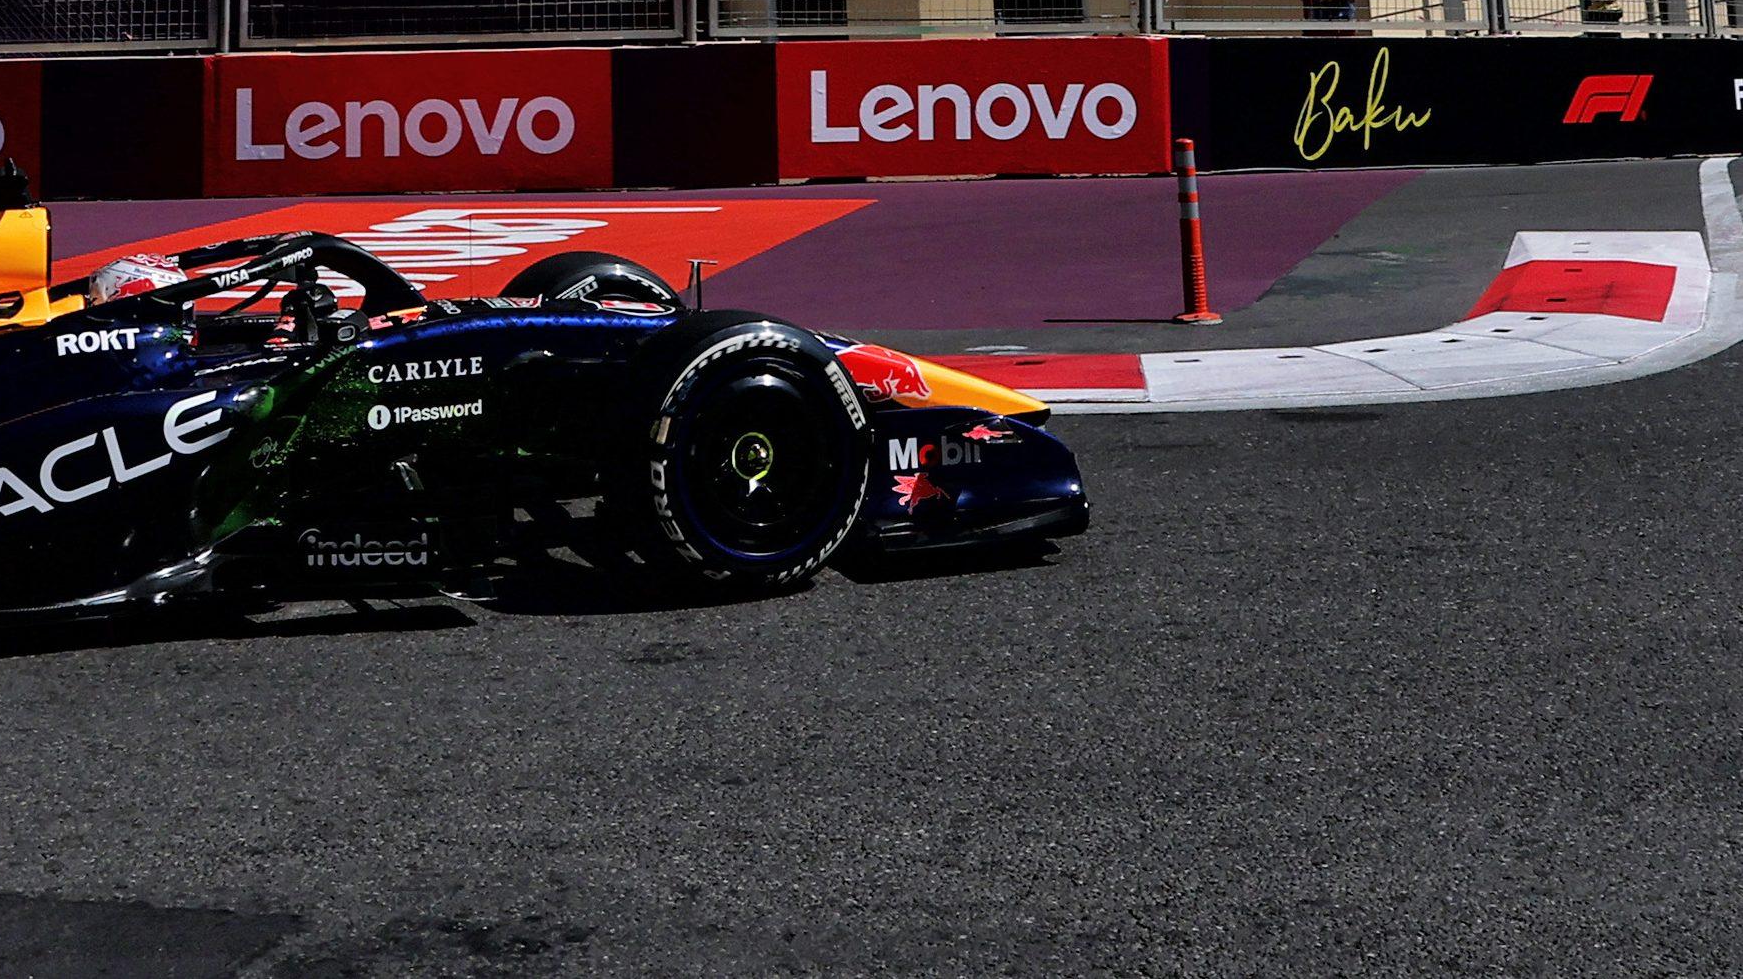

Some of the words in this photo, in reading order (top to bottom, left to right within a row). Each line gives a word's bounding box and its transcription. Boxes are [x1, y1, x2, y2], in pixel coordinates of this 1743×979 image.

[810, 70, 1137, 145] Lenovo
[1294, 46, 1432, 161] Baku
[235, 87, 575, 162] Lenovo
[212, 269, 250, 288] VISA
[57, 328, 140, 356] ROKT
[368, 356, 484, 383] CARLYLE
[393, 399, 483, 425] 1Password
[824, 360, 866, 430] PIRELLI
[303, 530, 428, 566] indeed
